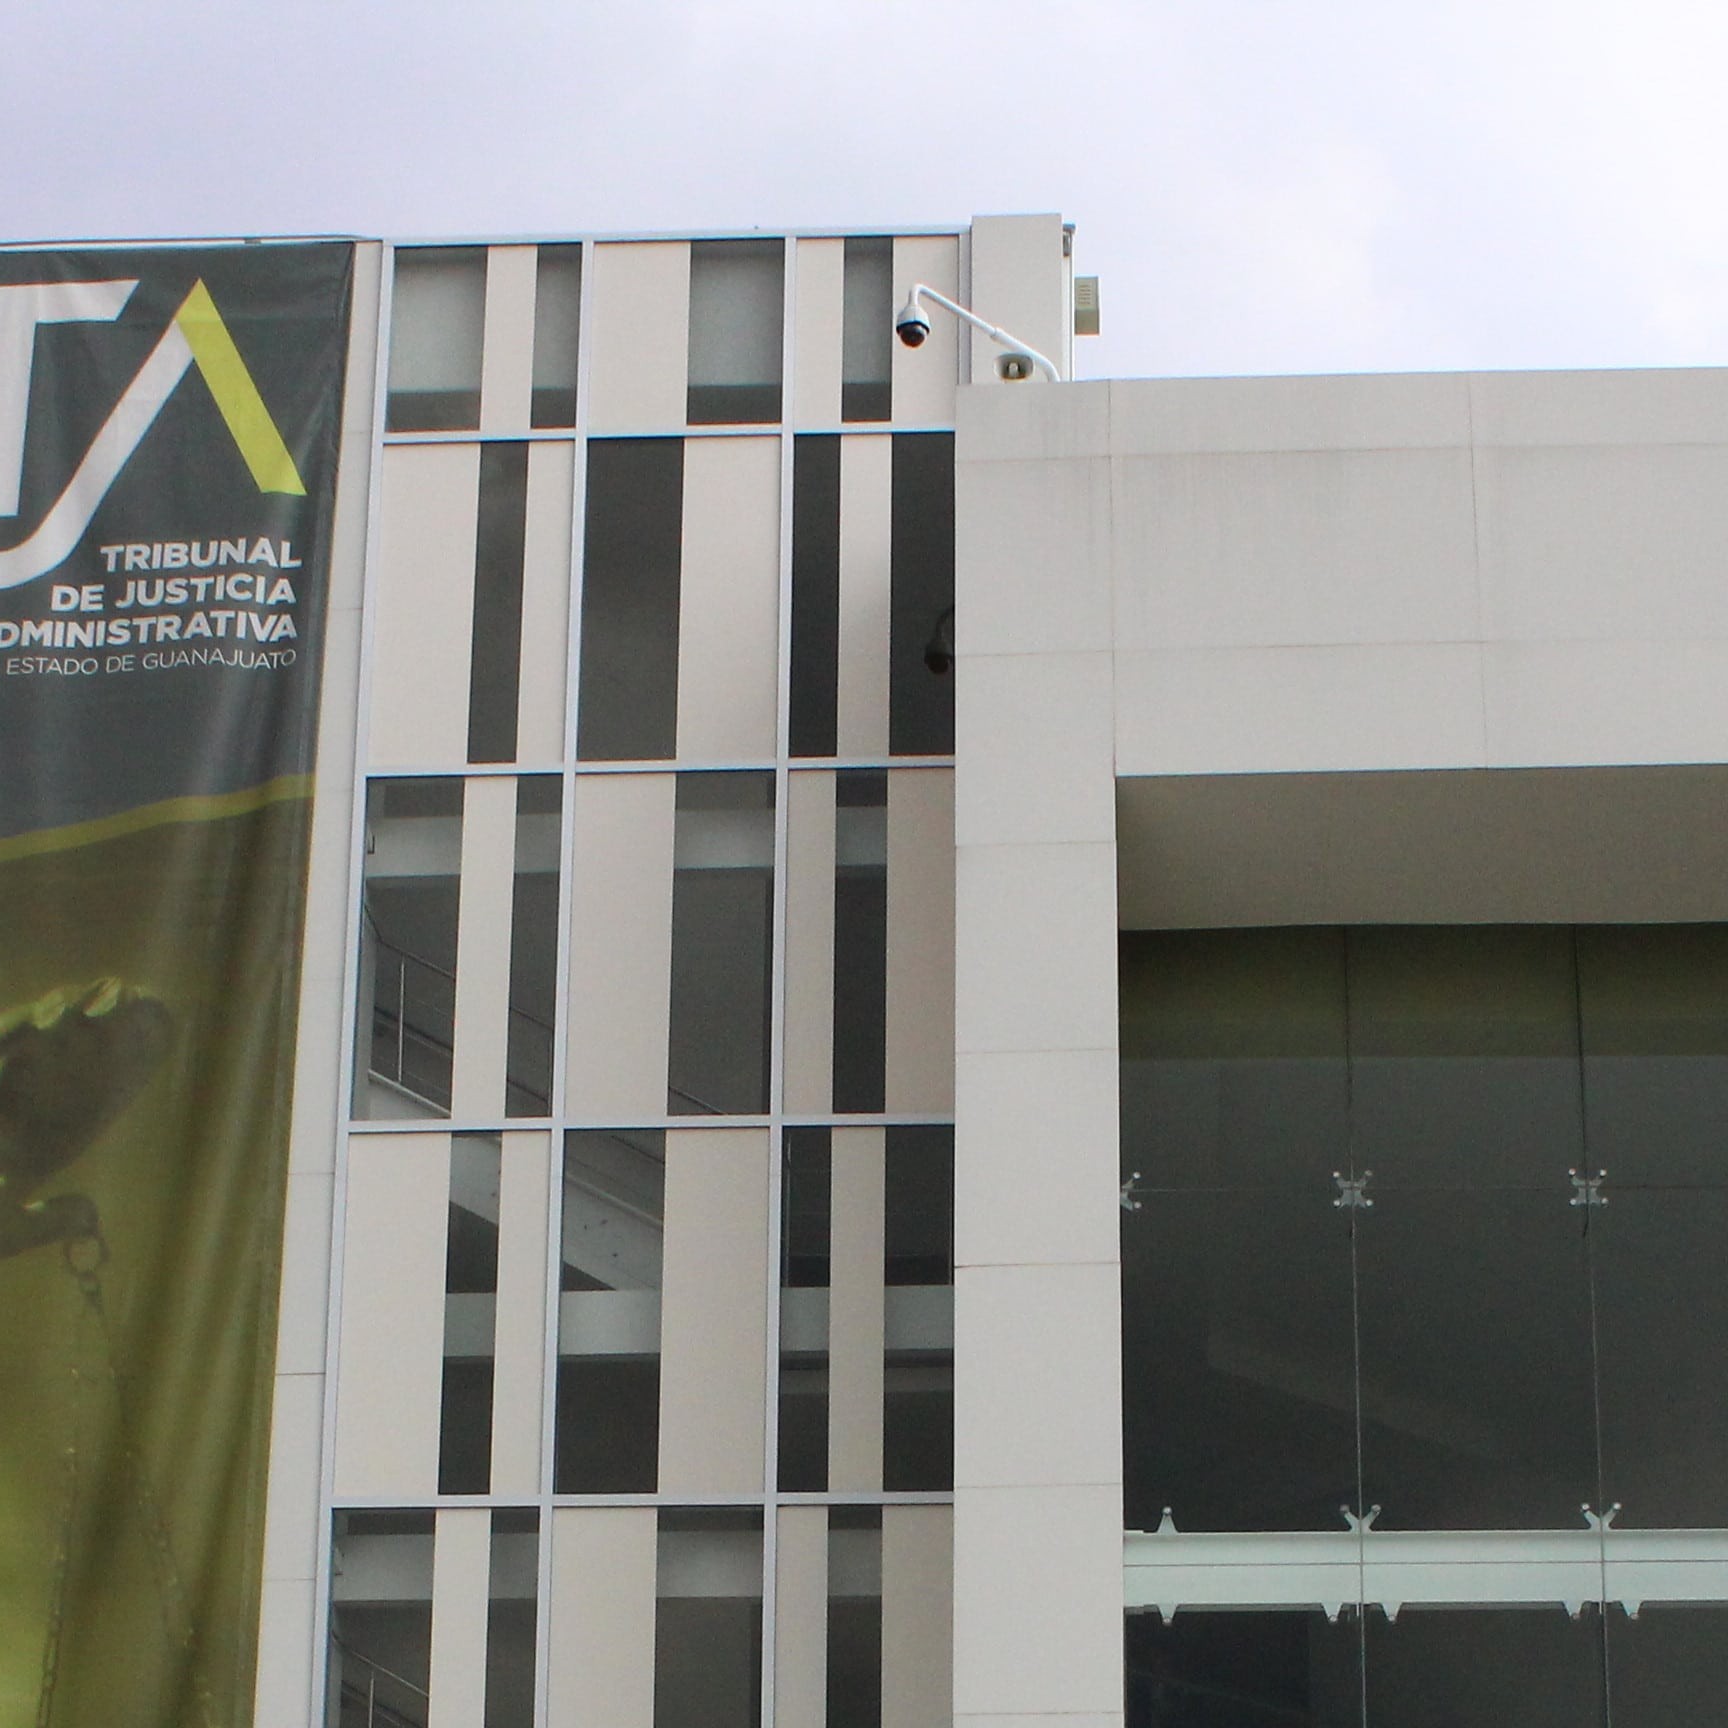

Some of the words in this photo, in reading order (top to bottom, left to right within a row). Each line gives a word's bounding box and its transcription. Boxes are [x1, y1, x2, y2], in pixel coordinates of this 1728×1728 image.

[100, 536, 301, 573] TRIBUNAL
[51, 584, 104, 612] DE
[116, 574, 296, 609] JUSTICIA
[6, 655, 99, 675] ESTADO
[106, 654, 135, 673] DE
[143, 648, 296, 671] GUANAJUATO
